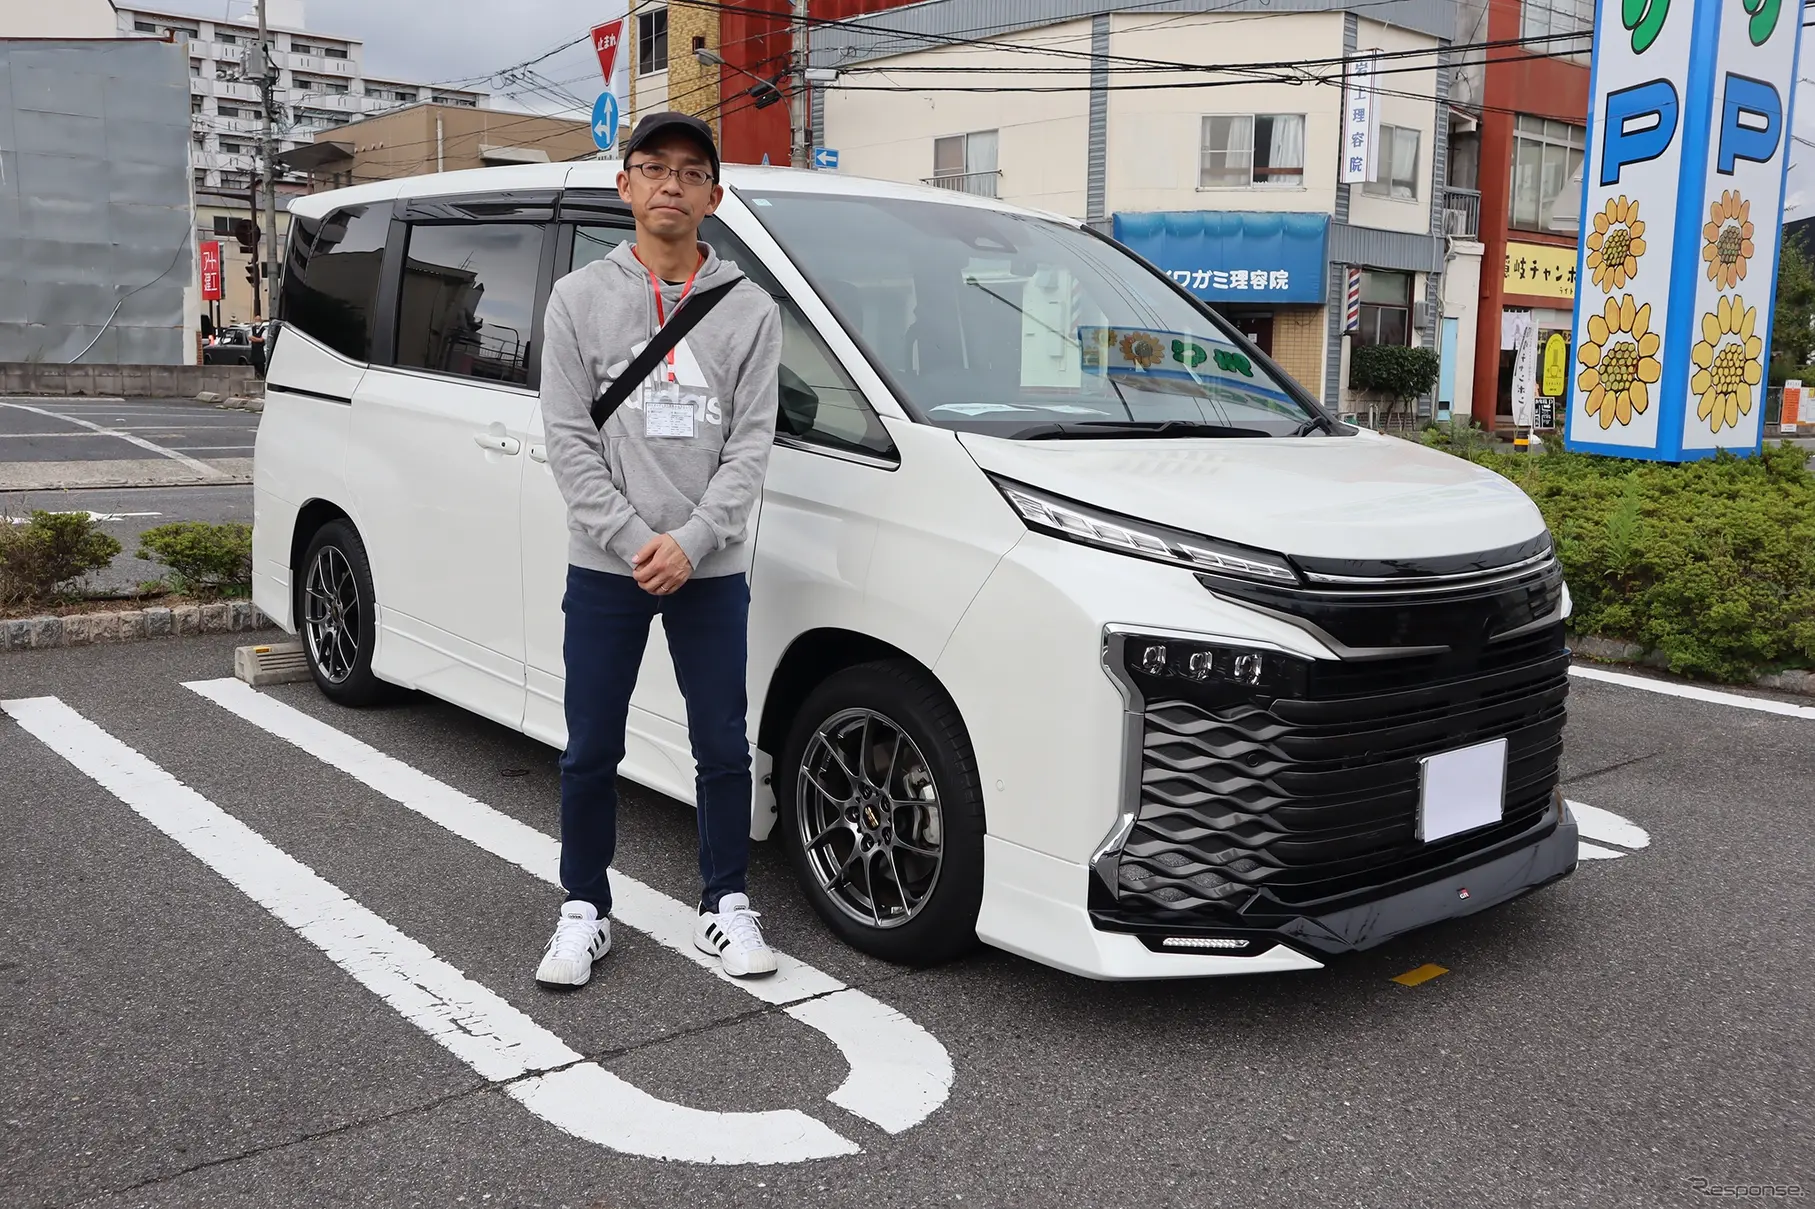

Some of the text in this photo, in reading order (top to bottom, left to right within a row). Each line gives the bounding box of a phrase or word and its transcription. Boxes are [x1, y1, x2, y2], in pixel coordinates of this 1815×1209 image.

[597, 33, 616, 51] 止まれ
[1349, 62, 1368, 173] 岩上理容院
[1600, 78, 1680, 187] P
[1717, 71, 1783, 176] P
[600, 373, 721, 425] didas
